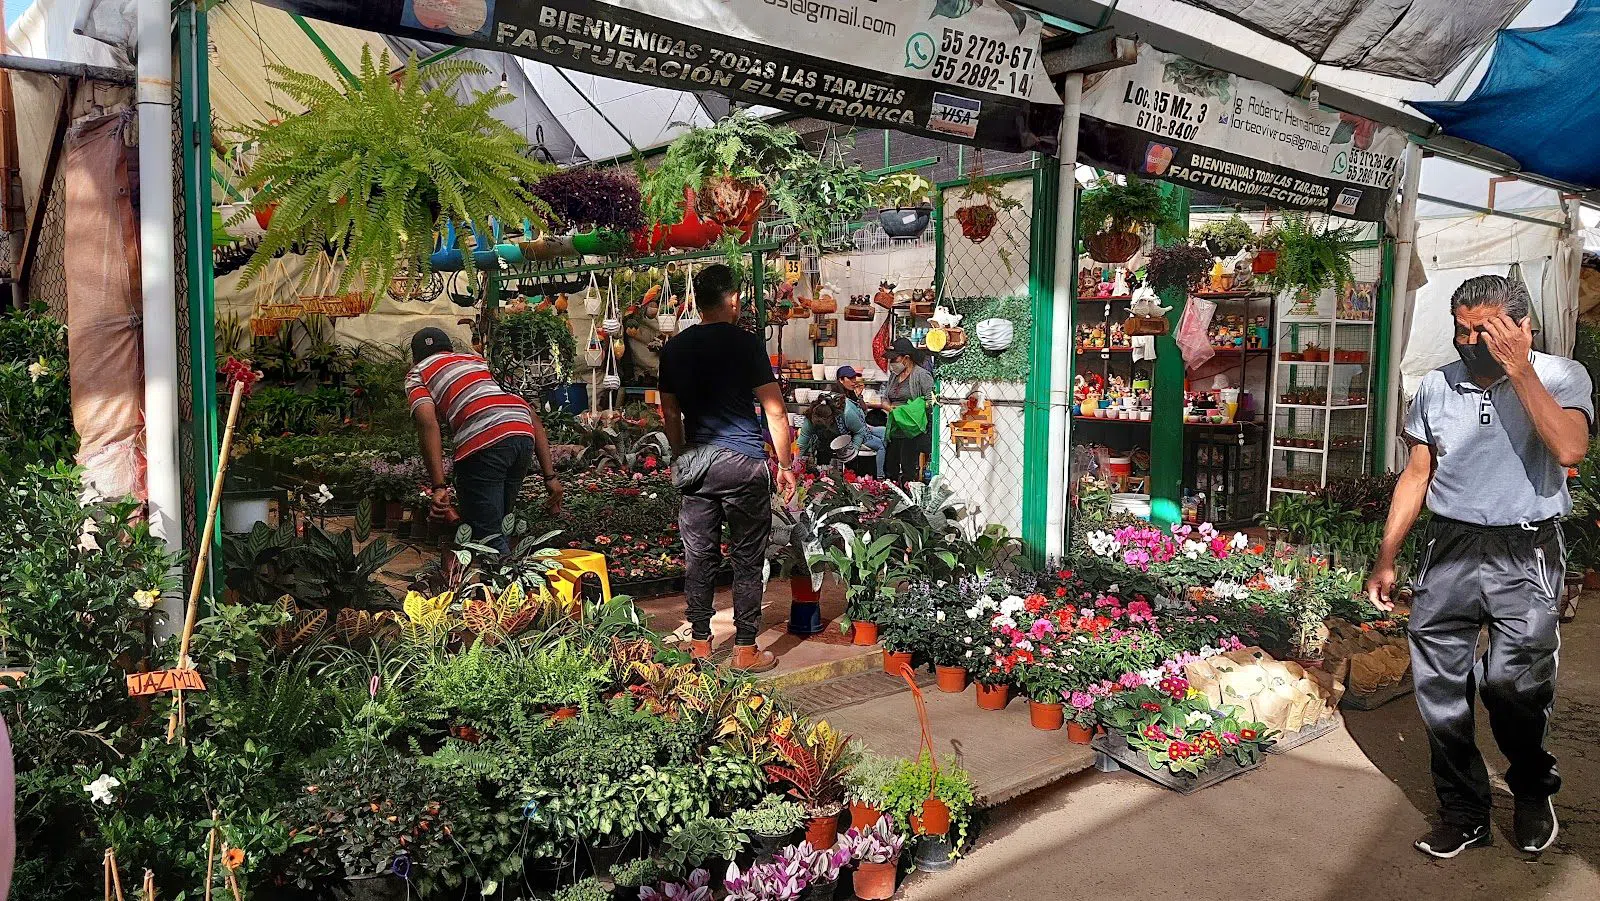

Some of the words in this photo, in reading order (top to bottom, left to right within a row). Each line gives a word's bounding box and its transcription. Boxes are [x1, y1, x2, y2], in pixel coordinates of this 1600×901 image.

[538, 5, 703, 60] BIENVENIDAS
[780, 65, 818, 89] LAS
[823, 74, 906, 105] TARJETAS
[941, 27, 964, 55] 55
[965, 34, 1036, 70] 2723-67
[496, 21, 735, 87] FACTURACIÓN
[739, 78, 915, 126] ELECTRÓNICA
[931, 54, 958, 80] 55
[941, 106, 971, 125] VISA
[1153, 90, 1170, 114] 35
[1197, 103, 1208, 124] 3
[1136, 109, 1199, 141] 6718-8400
[1167, 164, 1262, 195] FACTURACIÓN
[1190, 153, 1255, 180] BIENVENIDAS
[1273, 174, 1293, 188] LAS
[1292, 179, 1330, 197] TARJETAS
[1346, 164, 1358, 180] 55
[788, 261, 799, 273] 35
[131, 671, 204, 694] JAZMIN
